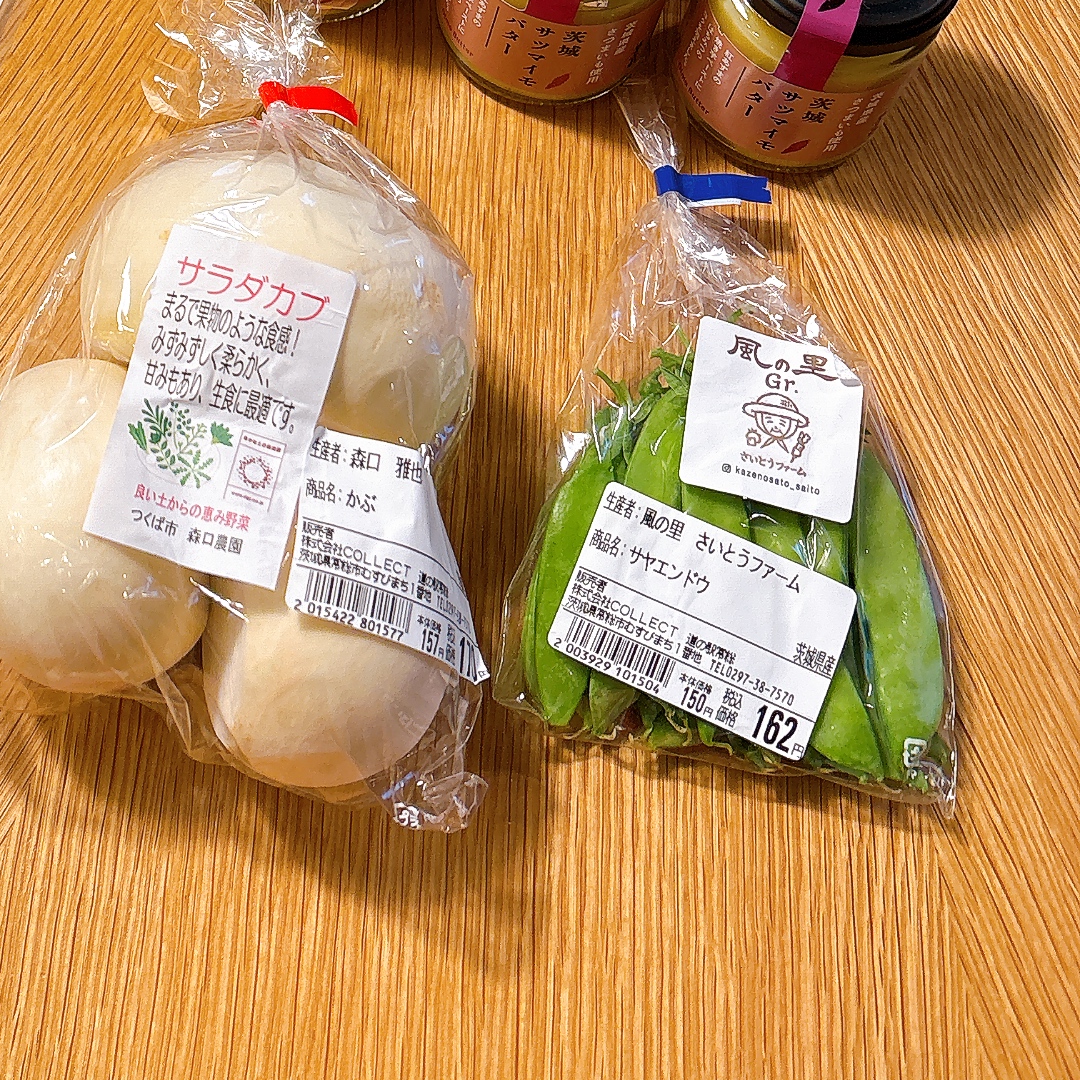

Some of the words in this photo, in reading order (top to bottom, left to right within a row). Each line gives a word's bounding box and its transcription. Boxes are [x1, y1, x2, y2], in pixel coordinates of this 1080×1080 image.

[501, 16, 528, 55] バター
[518, 26, 556, 87] サツマイモ
[557, 30, 588, 58] 茨城
[744, 79, 774, 117] バター
[801, 97, 836, 124] 茨城
[756, 90, 803, 151] サツマイモ
[177, 255, 331, 322] サラダカブ
[161, 291, 304, 357] まるで果物のような食感!
[150, 325, 272, 388] みずみずしく柔らかく、
[727, 334, 839, 382] 風の里
[764, 372, 799, 394] Gr.
[305, 477, 377, 513] 商品名：かぶ
[735, 465, 821, 496] kazenosato_saito
[133, 482, 253, 532] 良い土からの恵み野菜
[131, 507, 179, 536] つくば市
[186, 526, 245, 556] 森口農園
[603, 491, 685, 542] 生産者：風の里
[695, 531, 802, 593] さいとうファーム
[301, 534, 412, 577] 株式会社COLLECT
[589, 528, 711, 595] 商品名：サヤエンドウ
[575, 570, 609, 594] 販売者
[293, 599, 302, 611] 2
[307, 603, 354, 626] 015422
[359, 617, 405, 642] 801577
[571, 582, 680, 638] 株式会社COLLECT
[553, 637, 563, 649] 2
[565, 643, 612, 672] 003929
[616, 666, 660, 694] 101504
[792, 641, 837, 678] 茨城県産
[678, 672, 713, 695] 本体価格
[680, 686, 715, 718] 150円
[709, 659, 795, 707] TEL0297-38-7570
[722, 688, 744, 711] 税込
[715, 705, 739, 728] 価格
[751, 704, 805, 759] 162円
